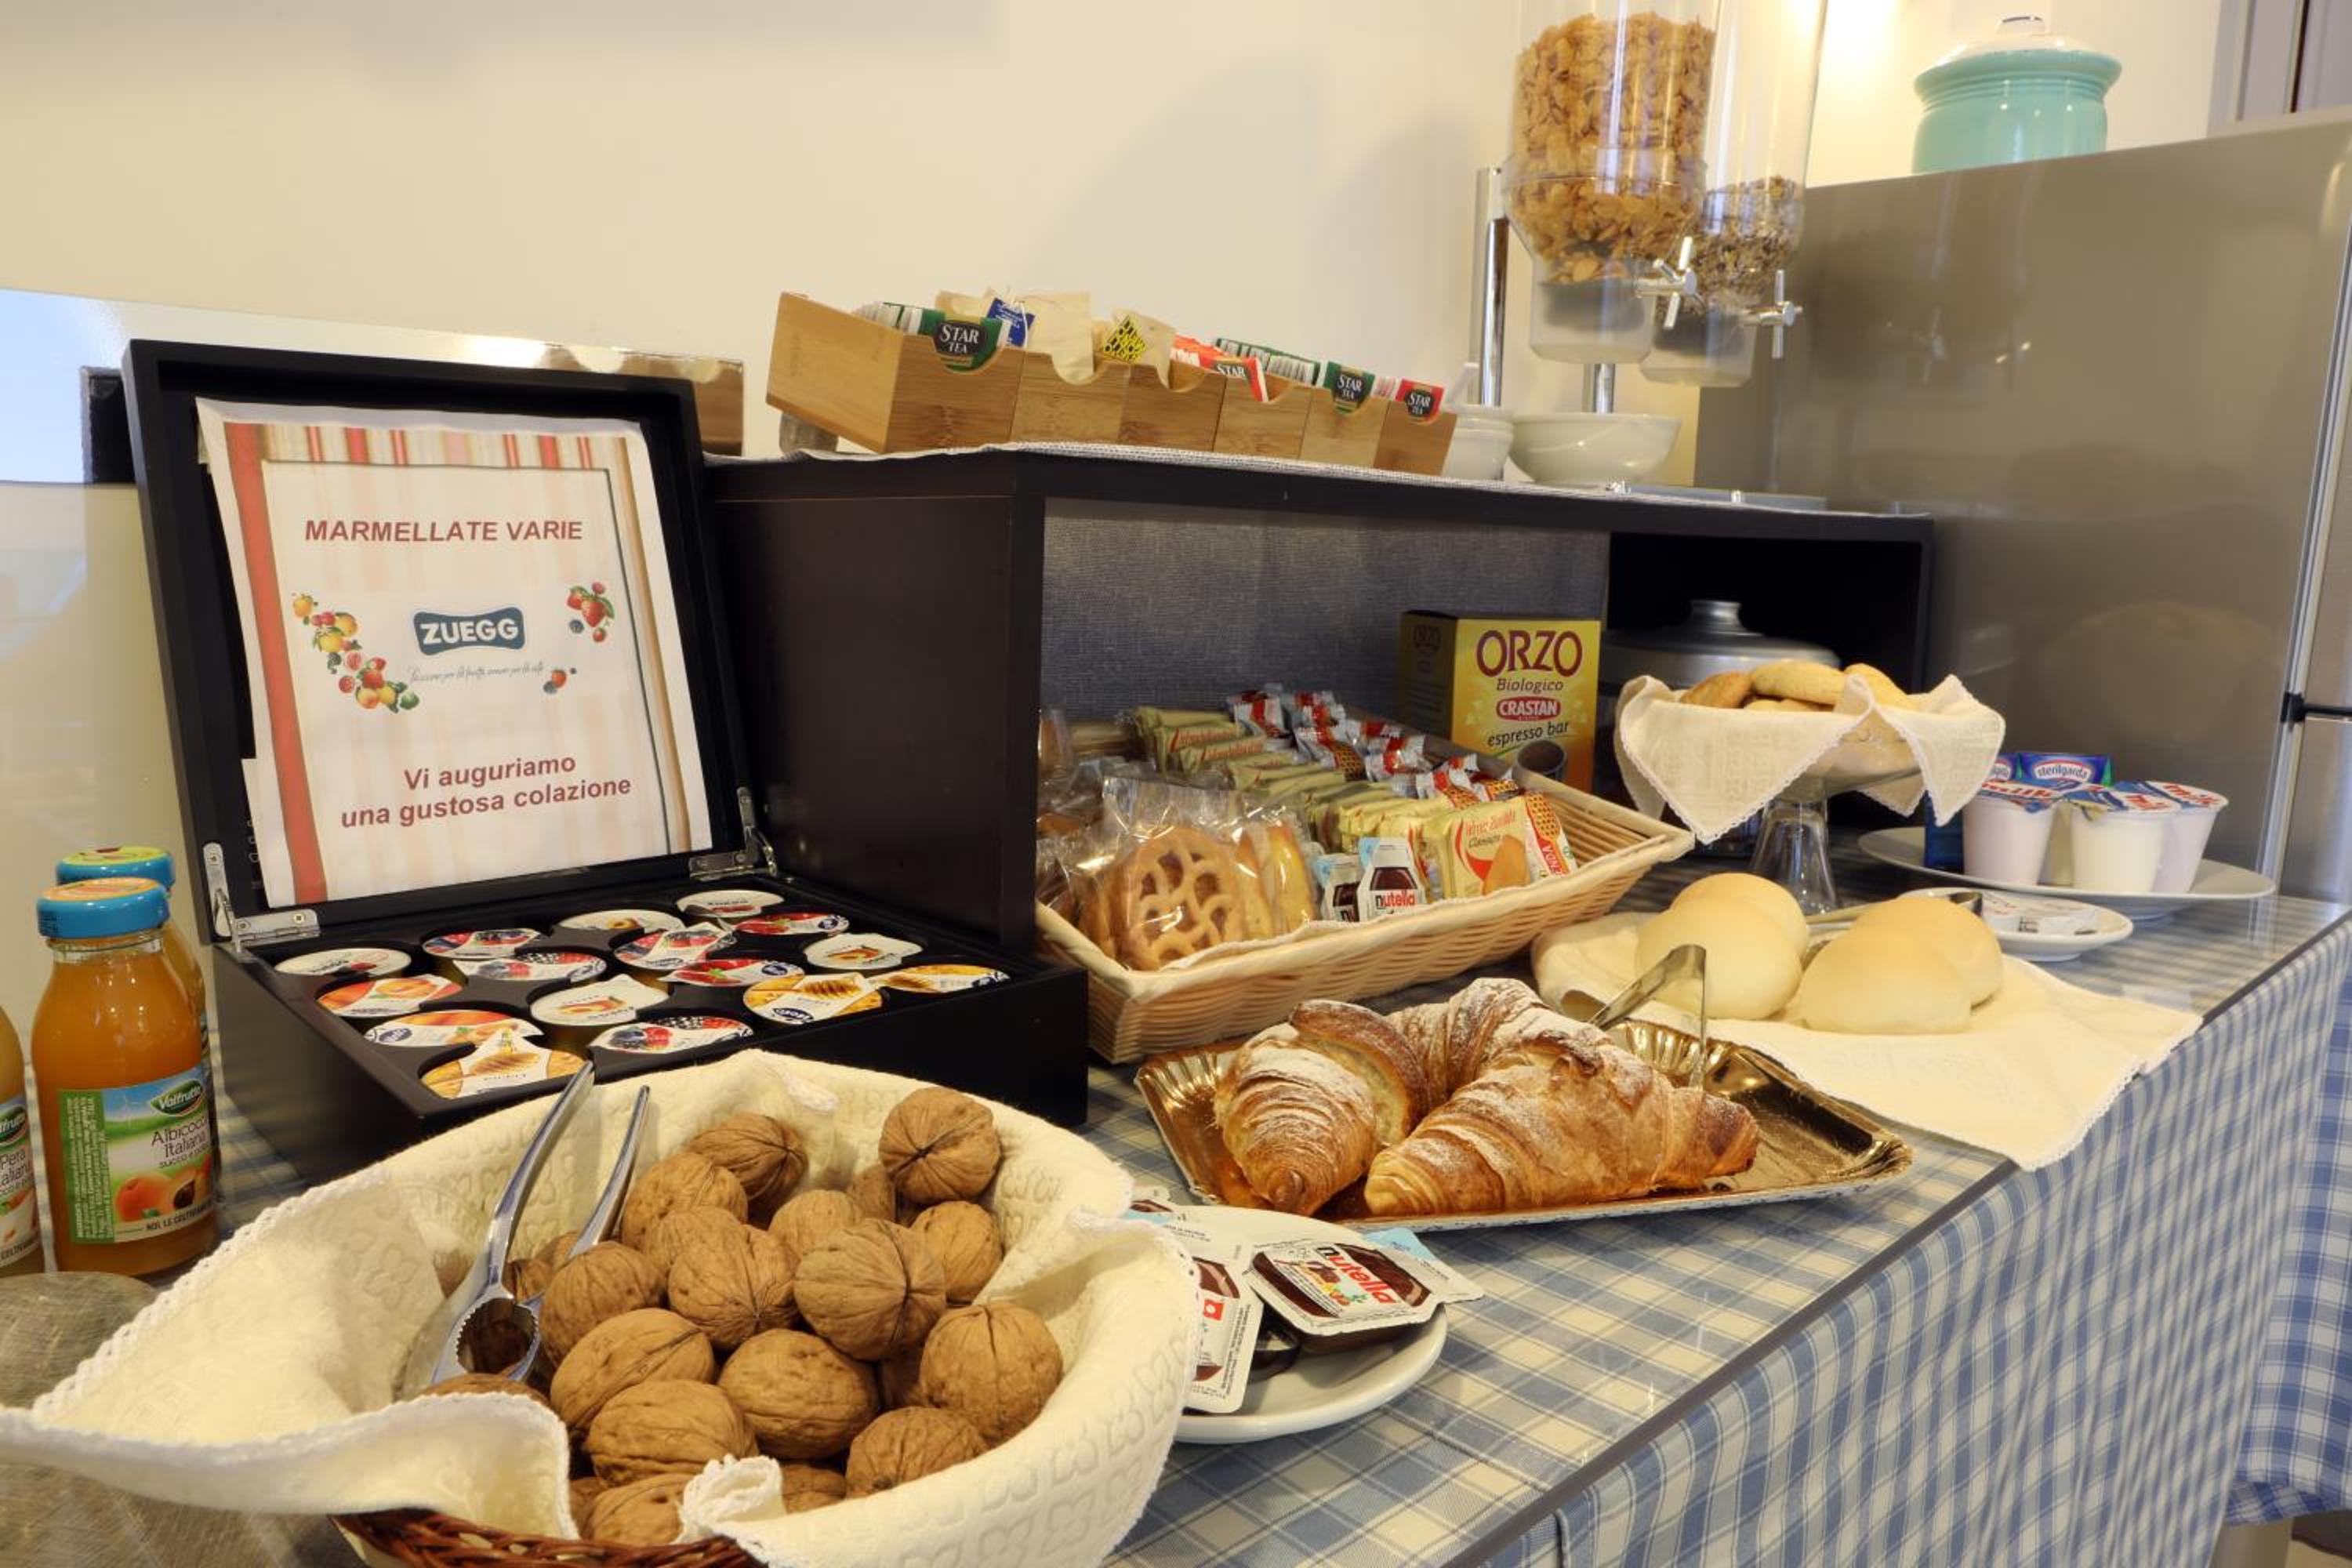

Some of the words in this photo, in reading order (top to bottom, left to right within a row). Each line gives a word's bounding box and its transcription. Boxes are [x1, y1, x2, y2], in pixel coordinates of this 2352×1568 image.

[940, 324, 979, 344] STAR
[948, 342, 967, 354] TEA
[1217, 365, 1246, 377] STAR
[1337, 375, 1362, 392] STAR
[1408, 393, 1431, 407] STAR
[305, 520, 498, 543] MARMELLATE
[506, 521, 583, 540] VARIE
[420, 619, 519, 645] ZUEGG
[1476, 630, 1583, 677] ORZO
[1497, 678, 1564, 694] Biologico
[1499, 700, 1557, 716] CRASTAN
[1487, 727, 1544, 748] espresso
[1547, 721, 1570, 736] bar
[405, 768, 429, 790] Vi
[438, 757, 576, 788] auguriamo
[342, 806, 390, 828] una
[400, 793, 505, 827] gustosa
[514, 779, 631, 808] colazione
[1375, 890, 1415, 909] nutella
[1316, 1247, 1398, 1304] nutella
